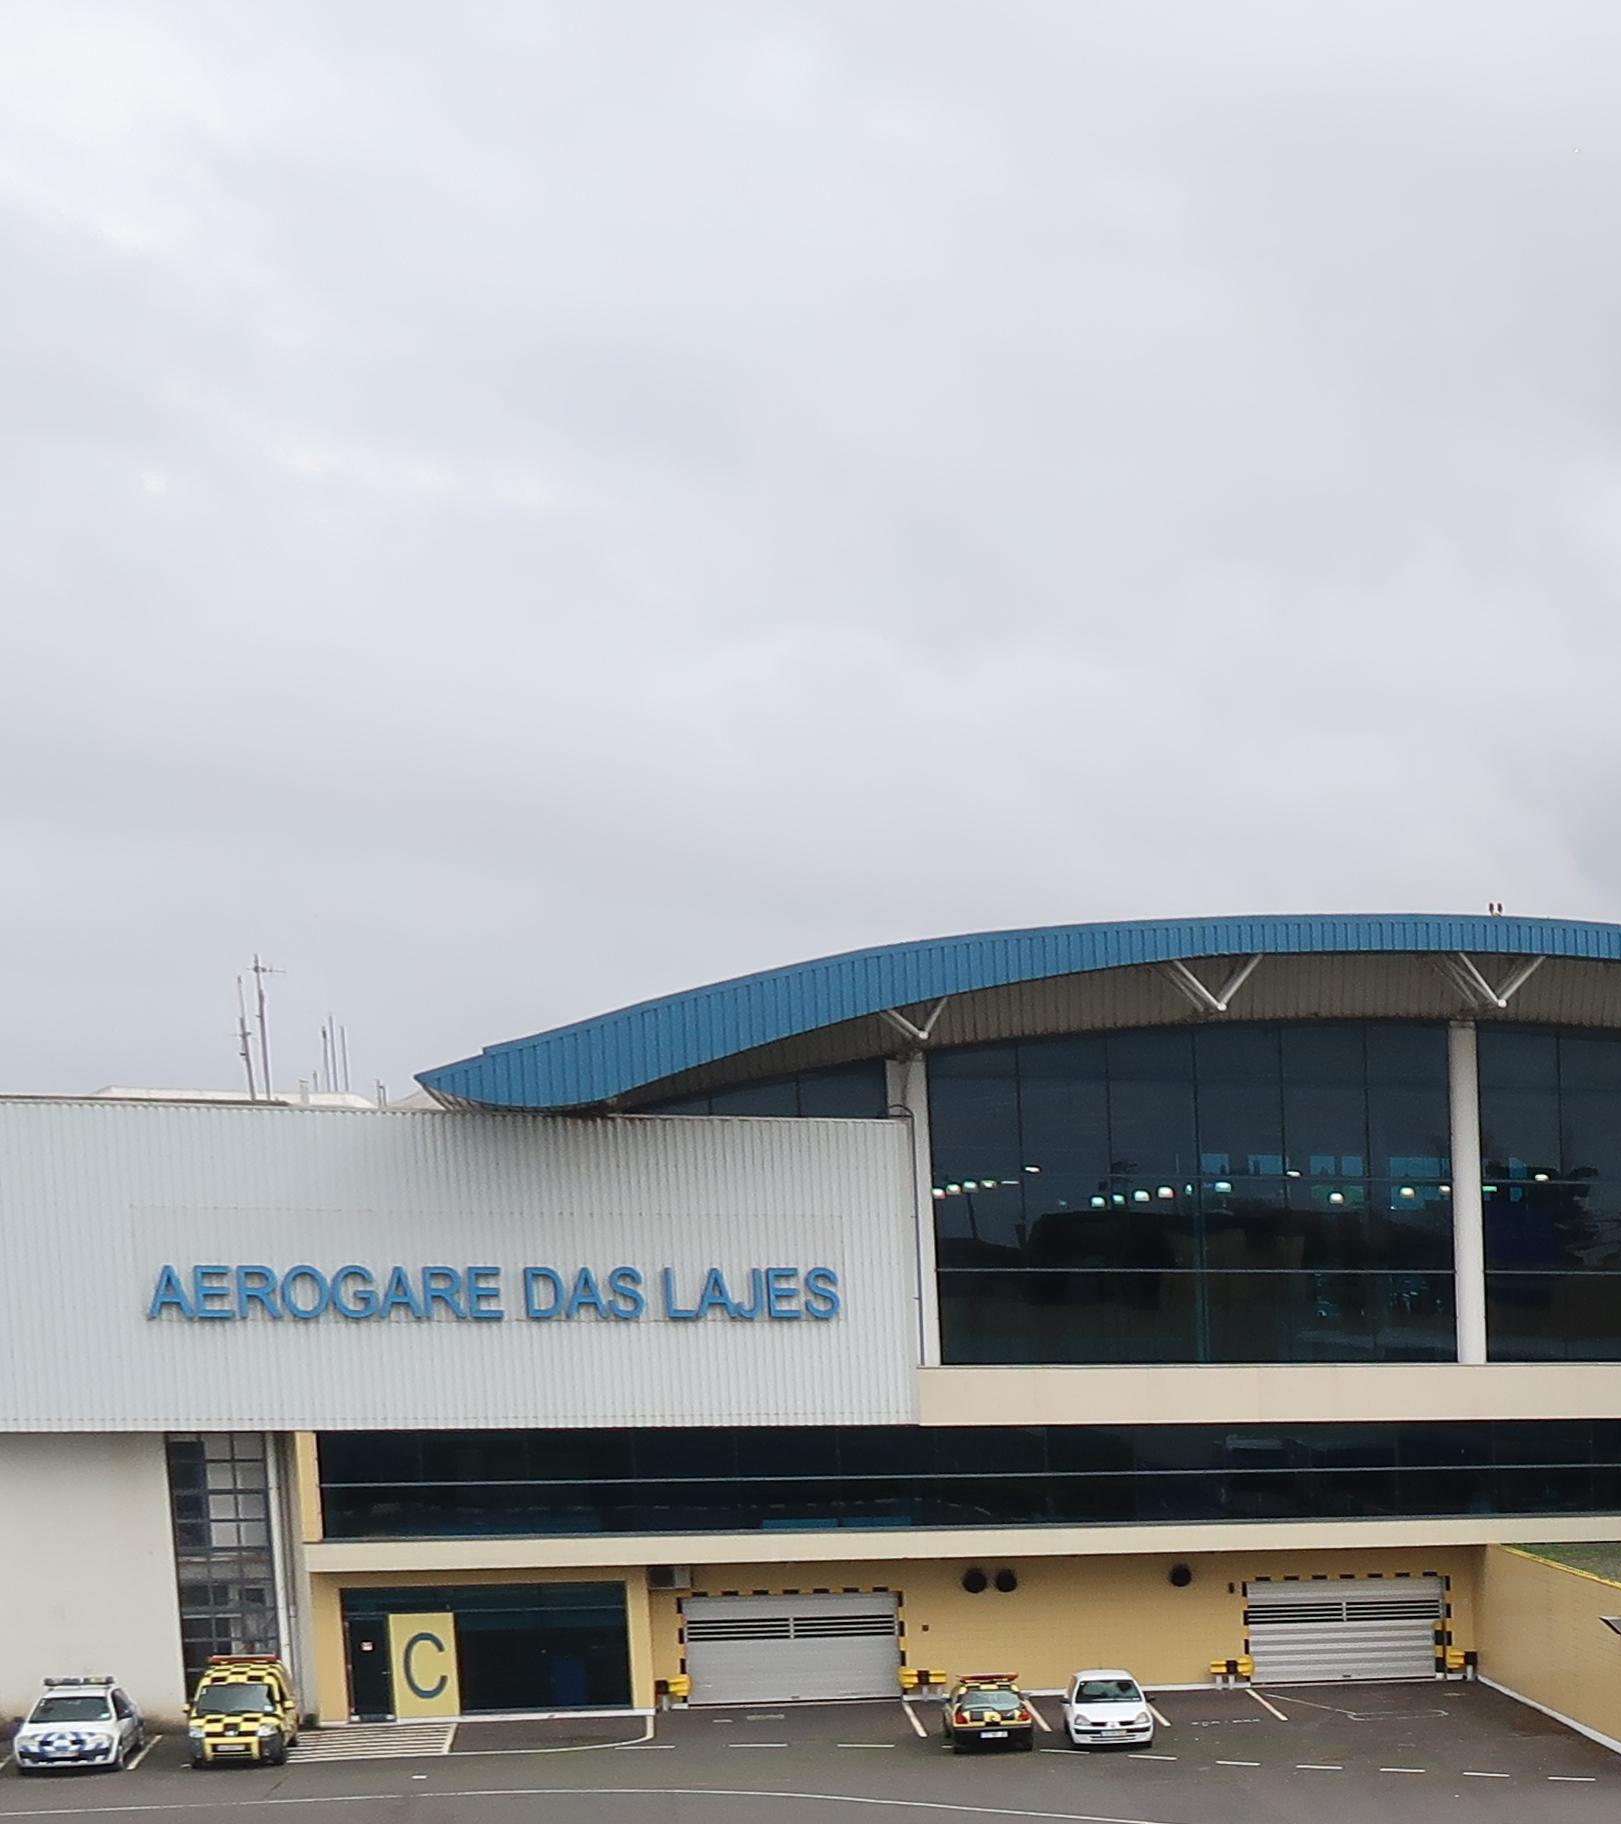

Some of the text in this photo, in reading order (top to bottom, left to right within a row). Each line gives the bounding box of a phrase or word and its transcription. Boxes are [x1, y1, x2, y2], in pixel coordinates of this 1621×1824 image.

[150, 1264, 842, 1321] AEROGARE DAS LAJES
[403, 1631, 448, 1700] C
